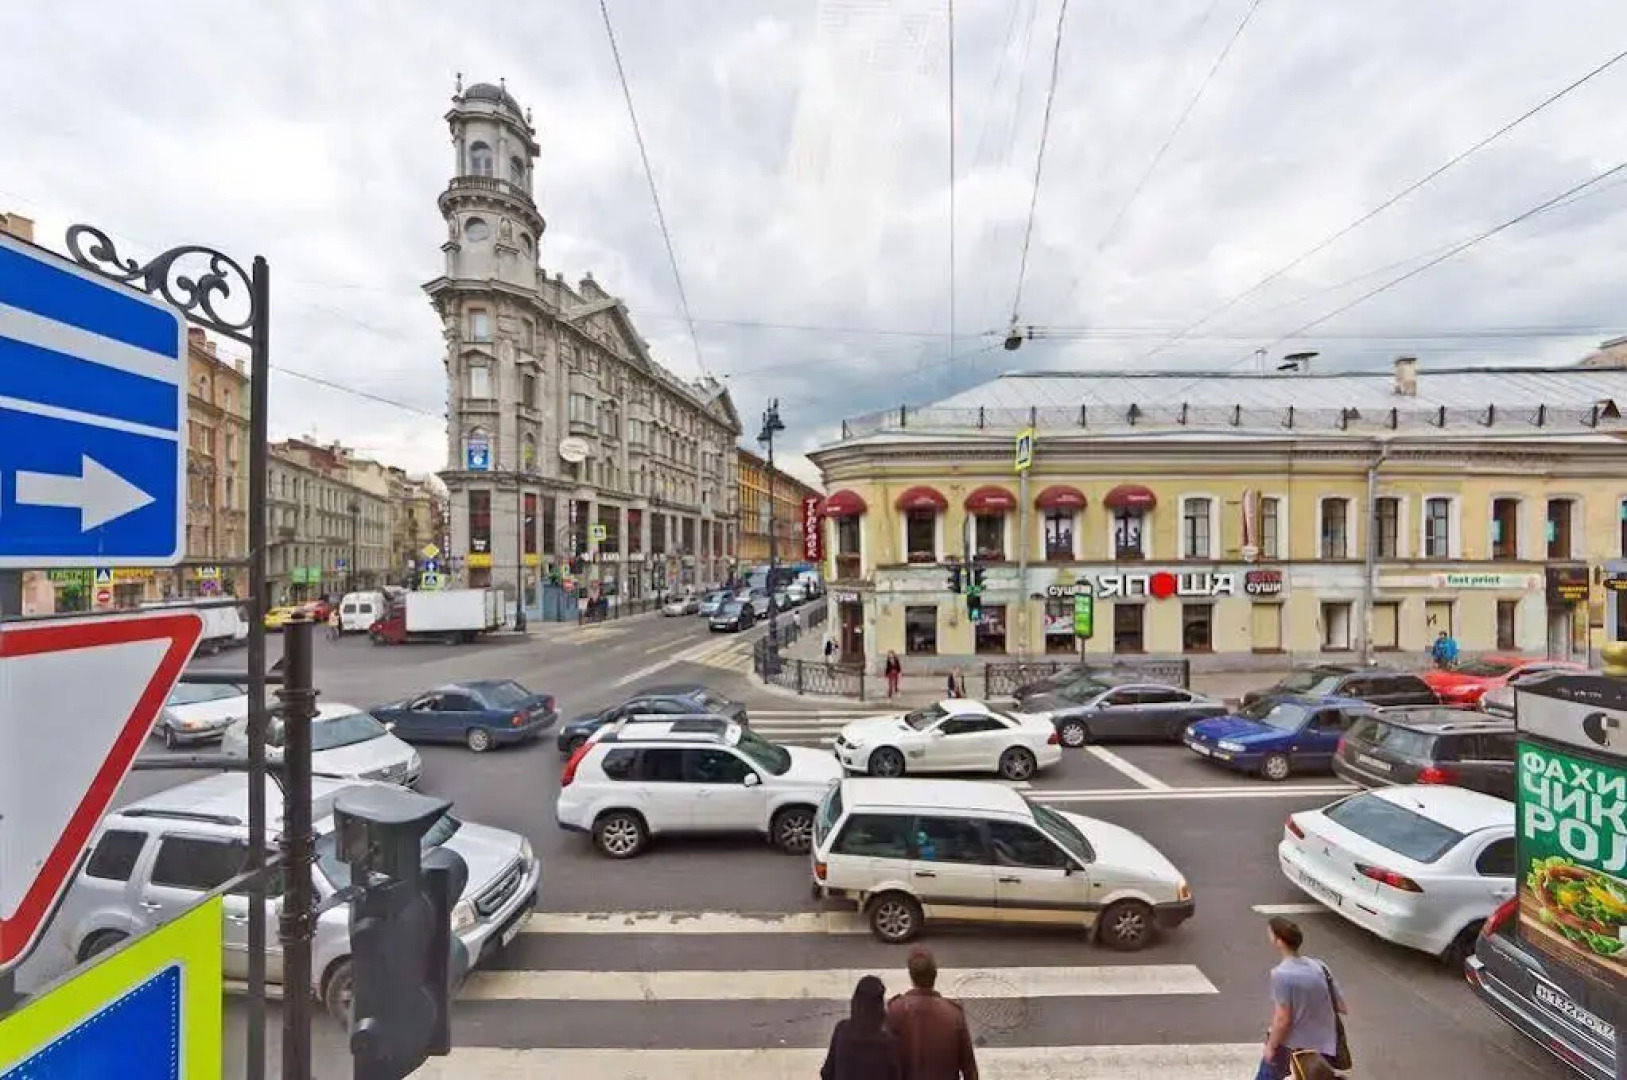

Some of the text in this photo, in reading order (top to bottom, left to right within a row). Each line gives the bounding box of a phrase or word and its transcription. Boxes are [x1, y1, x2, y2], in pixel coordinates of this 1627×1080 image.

[1446, 574, 1501, 587] fast print
[1049, 585, 1077, 597] суш
[1246, 582, 1281, 595] суши
